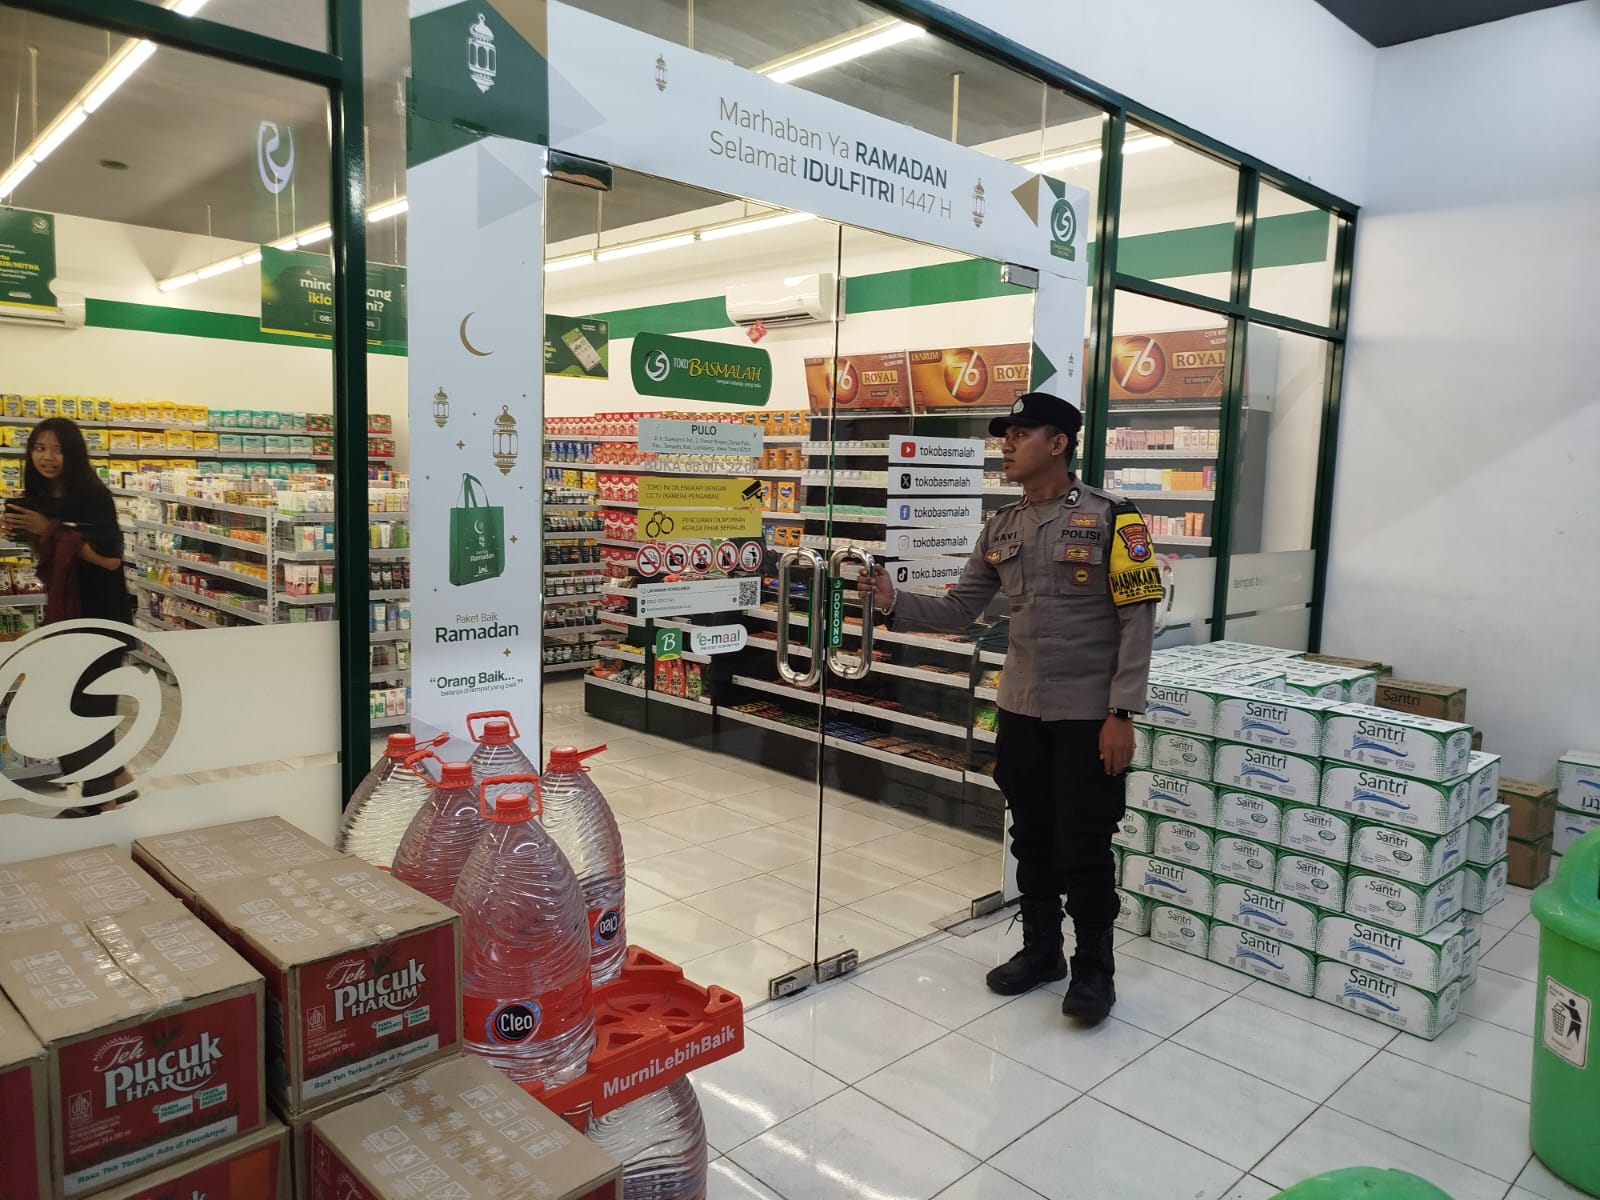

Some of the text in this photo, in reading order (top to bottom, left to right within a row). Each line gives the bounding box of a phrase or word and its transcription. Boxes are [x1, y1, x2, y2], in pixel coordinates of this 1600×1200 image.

[719, 96, 948, 190] Marhaban Ya RAMADAN
[709, 130, 952, 219] Selamat IDULFITRI 1447 H
[308, 291, 332, 306] ikla
[367, 287, 392, 302] ang
[673, 357, 762, 382] TOKO BASMALAH
[1175, 352, 1225, 367] ROYAL
[864, 372, 897, 384] ROYAL
[996, 366, 1029, 380] ROYA
[691, 424, 717, 436] PULO
[919, 445, 976, 459] tokobasmalah
[643, 459, 681, 472] BUKA
[914, 475, 971, 488] tokobasmalah
[913, 505, 970, 519] tokobasmalah
[912, 535, 968, 548] tokobasmalah
[1060, 528, 1101, 542] POLISI
[911, 565, 964, 580] toko.basmala
[456, 611, 498, 624] Paket Baik
[832, 593, 840, 644] DORONG
[435, 622, 519, 643] Ramadan
[662, 632, 676, 652] B
[699, 629, 741, 647] e-maal
[1150, 686, 1189, 703] Santri
[1383, 690, 1420, 707] Santri
[1245, 702, 1288, 722] Santri
[1357, 720, 1405, 743] Santri
[1169, 738, 1193, 752] Santri
[1245, 748, 1288, 770] Santri
[1152, 774, 1189, 794] Santri
[1358, 772, 1409, 796] Santri
[1236, 795, 1264, 812] Santri
[1303, 811, 1333, 828] Santri
[1171, 824, 1196, 840] Santri
[1376, 829, 1409, 849] Santri
[1232, 840, 1260, 857] Santri
[1148, 860, 1185, 881] Santri
[1296, 859, 1325, 877] Santri
[1369, 880, 1402, 899] Santri
[1242, 889, 1286, 913] Santri
[1167, 908, 1193, 926] Santri
[1239, 931, 1281, 956] Santri
[1353, 923, 1402, 951] Santri
[326, 960, 367, 989] Teh
[1349, 967, 1397, 998] Santri
[333, 957, 427, 1023] pucuk
[351, 985, 420, 1018] HARUM
[500, 1013, 533, 1032] Cleo
[93, 1036, 130, 1062] MINUMAN
[94, 1036, 146, 1072] Teh
[104, 1031, 224, 1110] pucuk
[603, 1025, 736, 1100] MurniLebihBaik
[126, 1063, 213, 1103] HARUM
[314, 1078, 332, 1089] Rasa
[347, 1063, 373, 1076] Terbaik
[374, 1058, 387, 1067] Ada
[78, 1172, 100, 1184] Rasa
[121, 1152, 154, 1169] Terbaik
[156, 1144, 174, 1157] Ada
[185, 1125, 228, 1146] Pucuknya!
